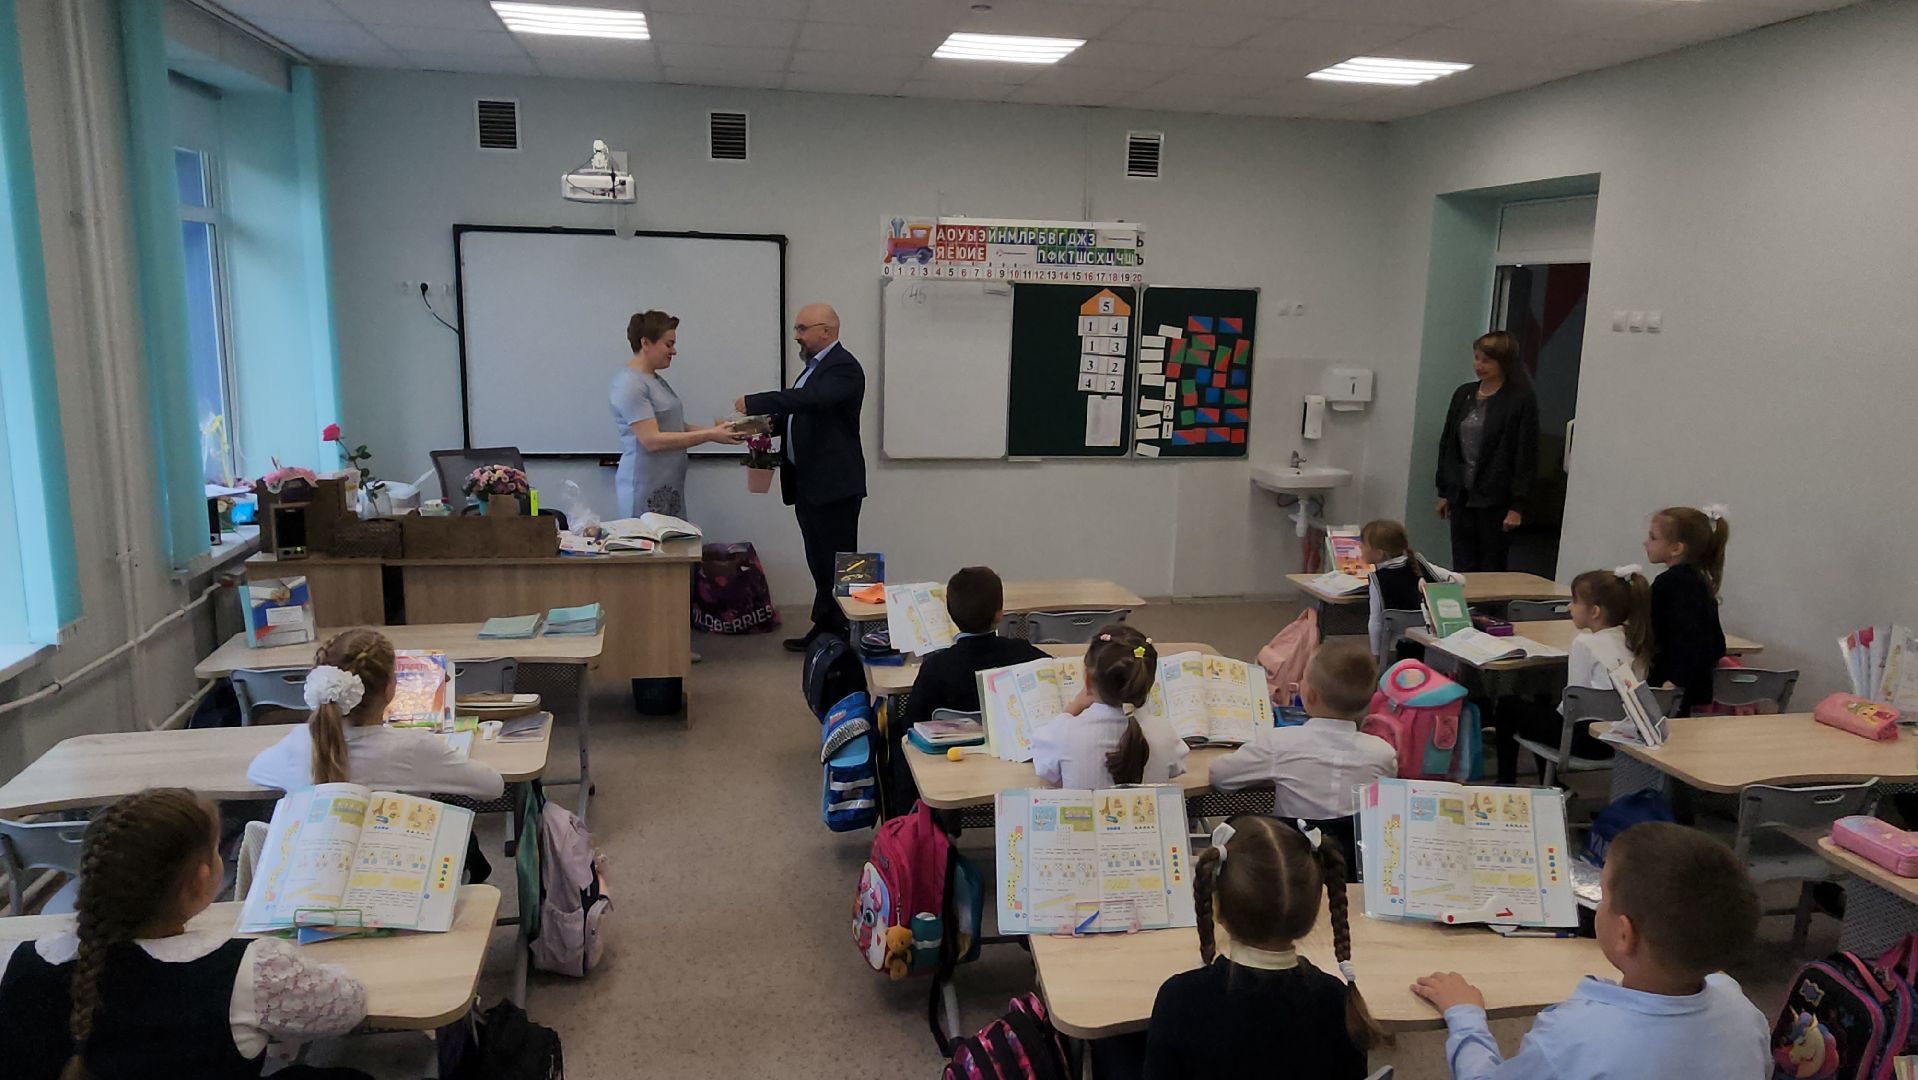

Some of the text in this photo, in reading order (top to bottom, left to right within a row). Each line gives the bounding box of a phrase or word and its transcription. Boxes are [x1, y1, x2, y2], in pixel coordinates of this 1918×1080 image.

[884, 266, 1142, 282] 0 1 2 3 4 5 6 7 8 9 10 11 12 13 14 15 16 17 18 19 20
[1103, 301, 1110, 312] 5
[1088, 321, 1119, 332] 1 4
[1090, 341, 1120, 352] 1 3
[1087, 360, 1118, 373] 3 2
[1085, 379, 1116, 391] 4 2
[1164, 404, 1172, 418] ?
[1166, 424, 1170, 437] !
[693, 604, 773, 633] ILDBERRIES
